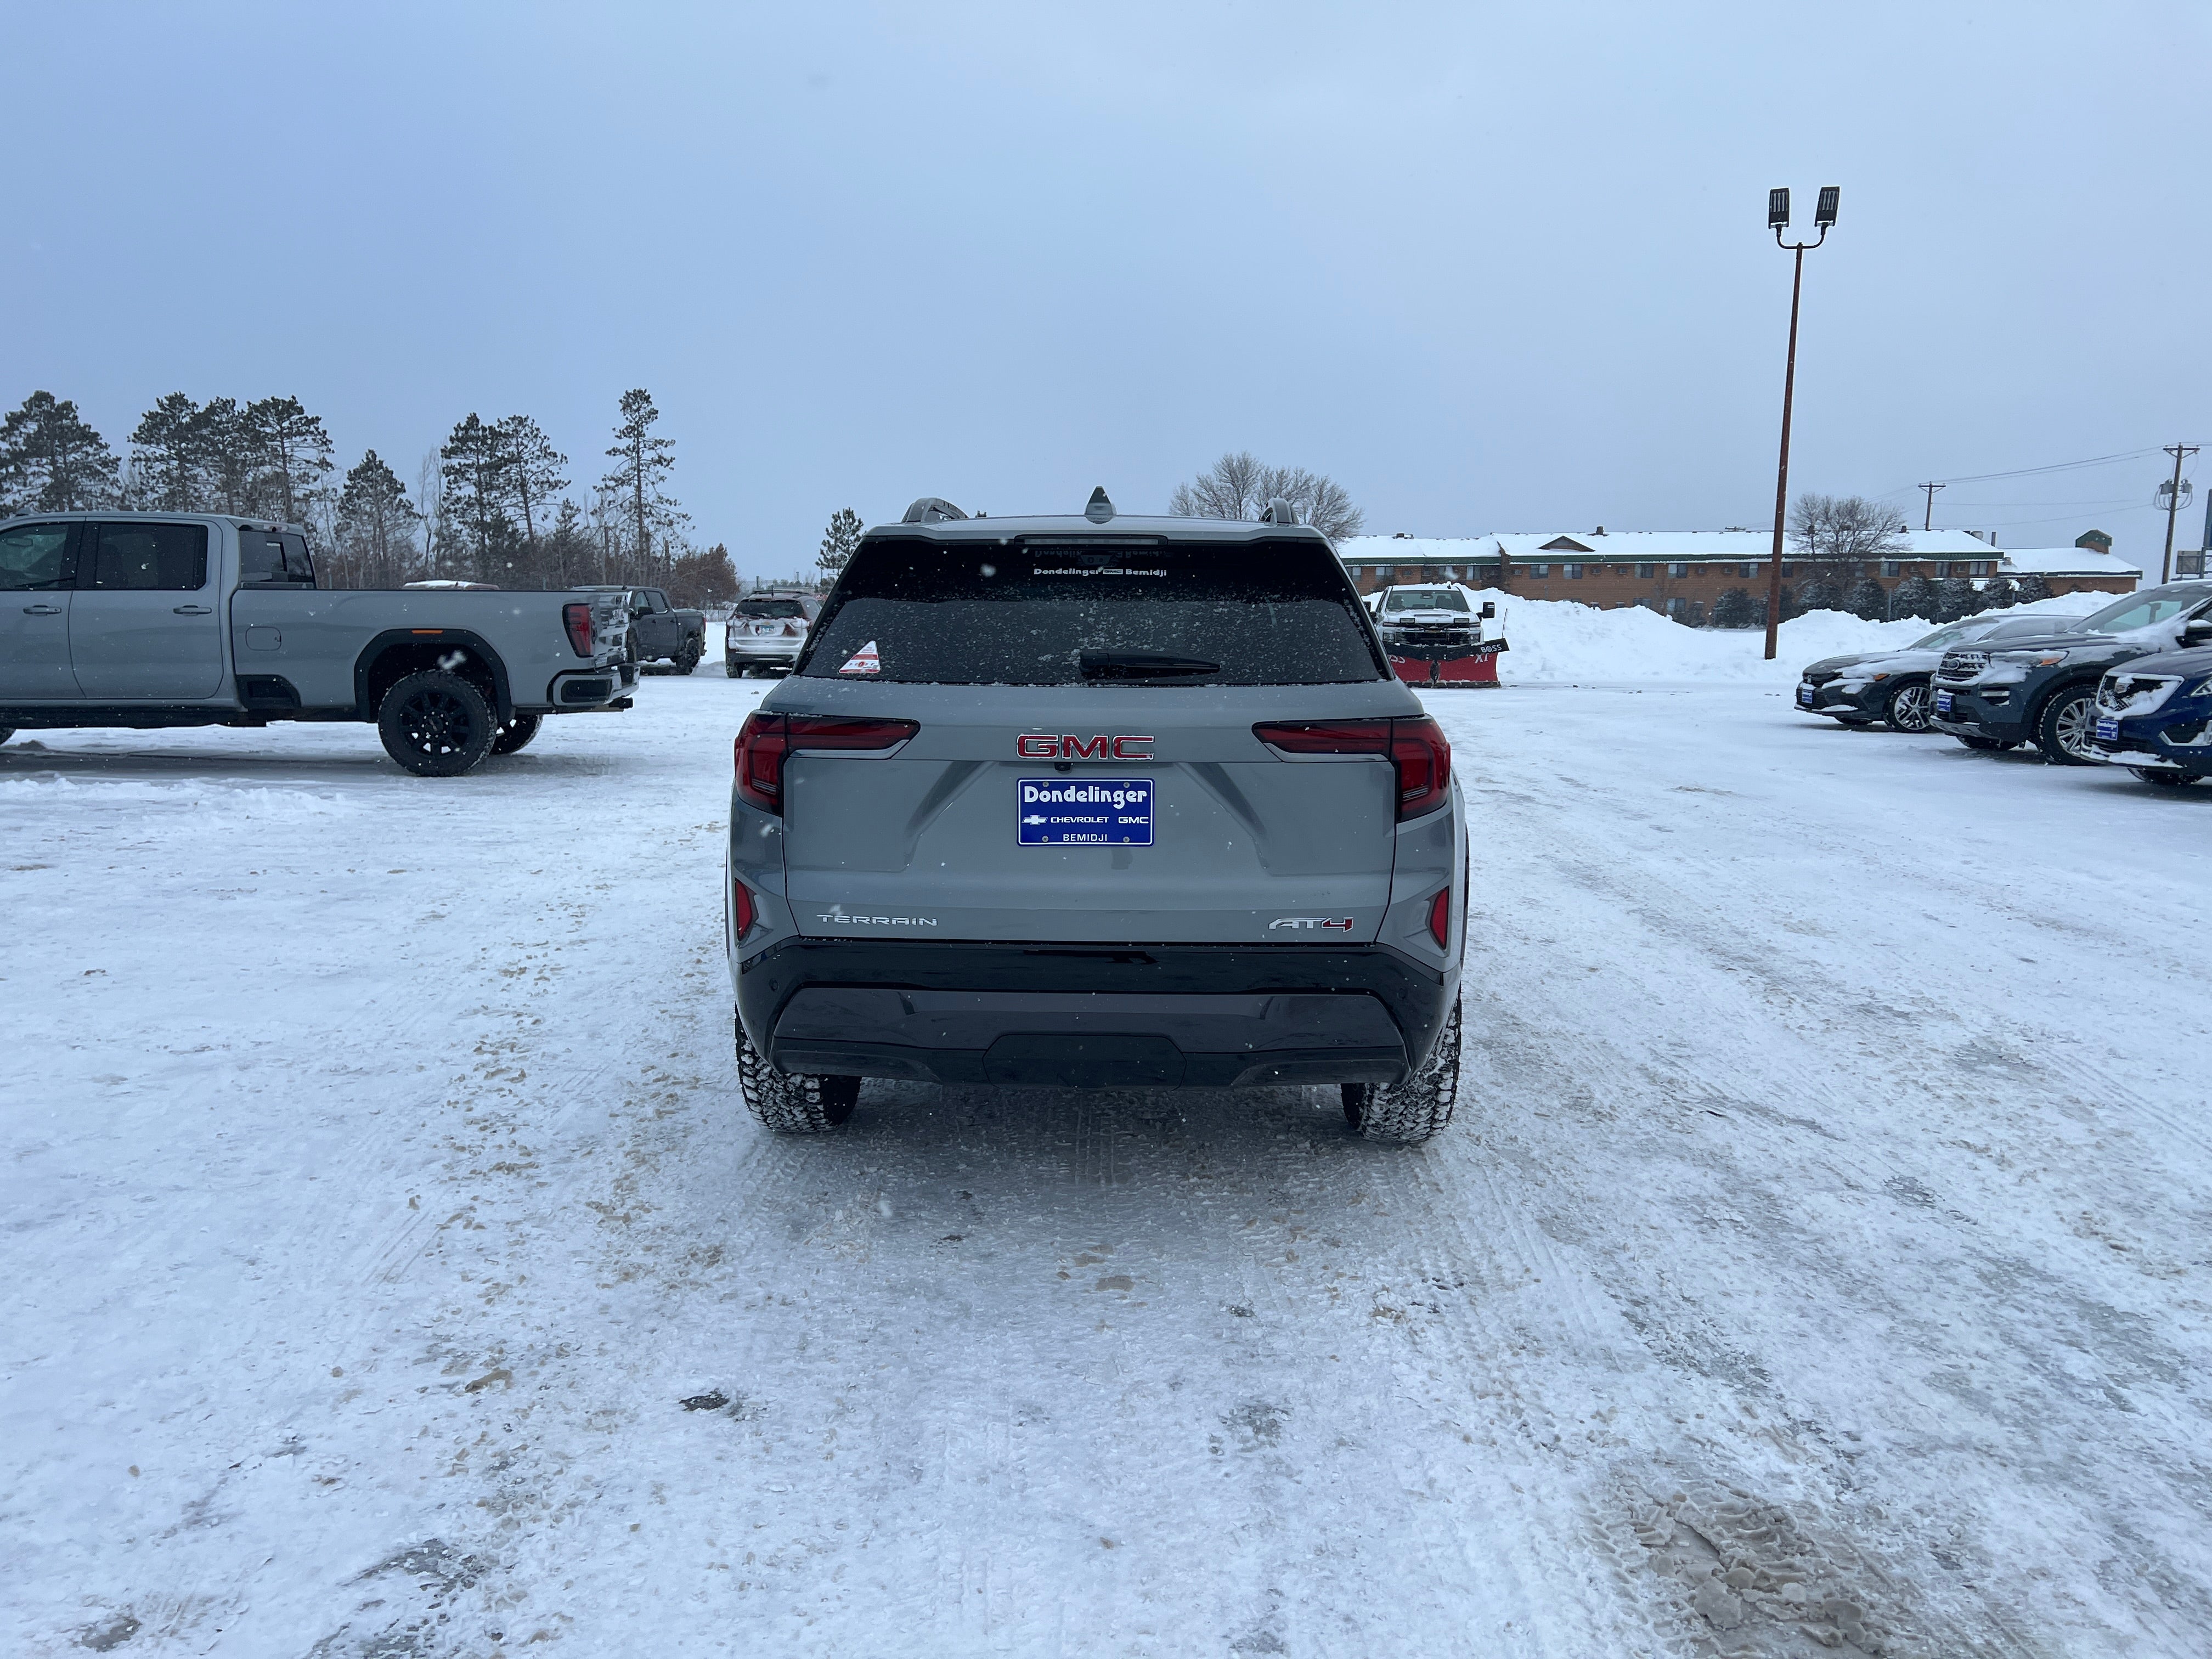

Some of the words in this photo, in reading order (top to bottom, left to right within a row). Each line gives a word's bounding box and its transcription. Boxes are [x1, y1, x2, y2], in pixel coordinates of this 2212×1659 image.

[1034, 568, 1100, 577] Dondelinger
[1125, 569, 1167, 577] Bemidji
[1480, 644, 1502, 653] BOSS
[1017, 734, 1155, 760] GMC
[1024, 786, 1147, 809] Dondelinger
[816, 914, 938, 926] TERRAIN
[1269, 917, 1354, 933] AT4
